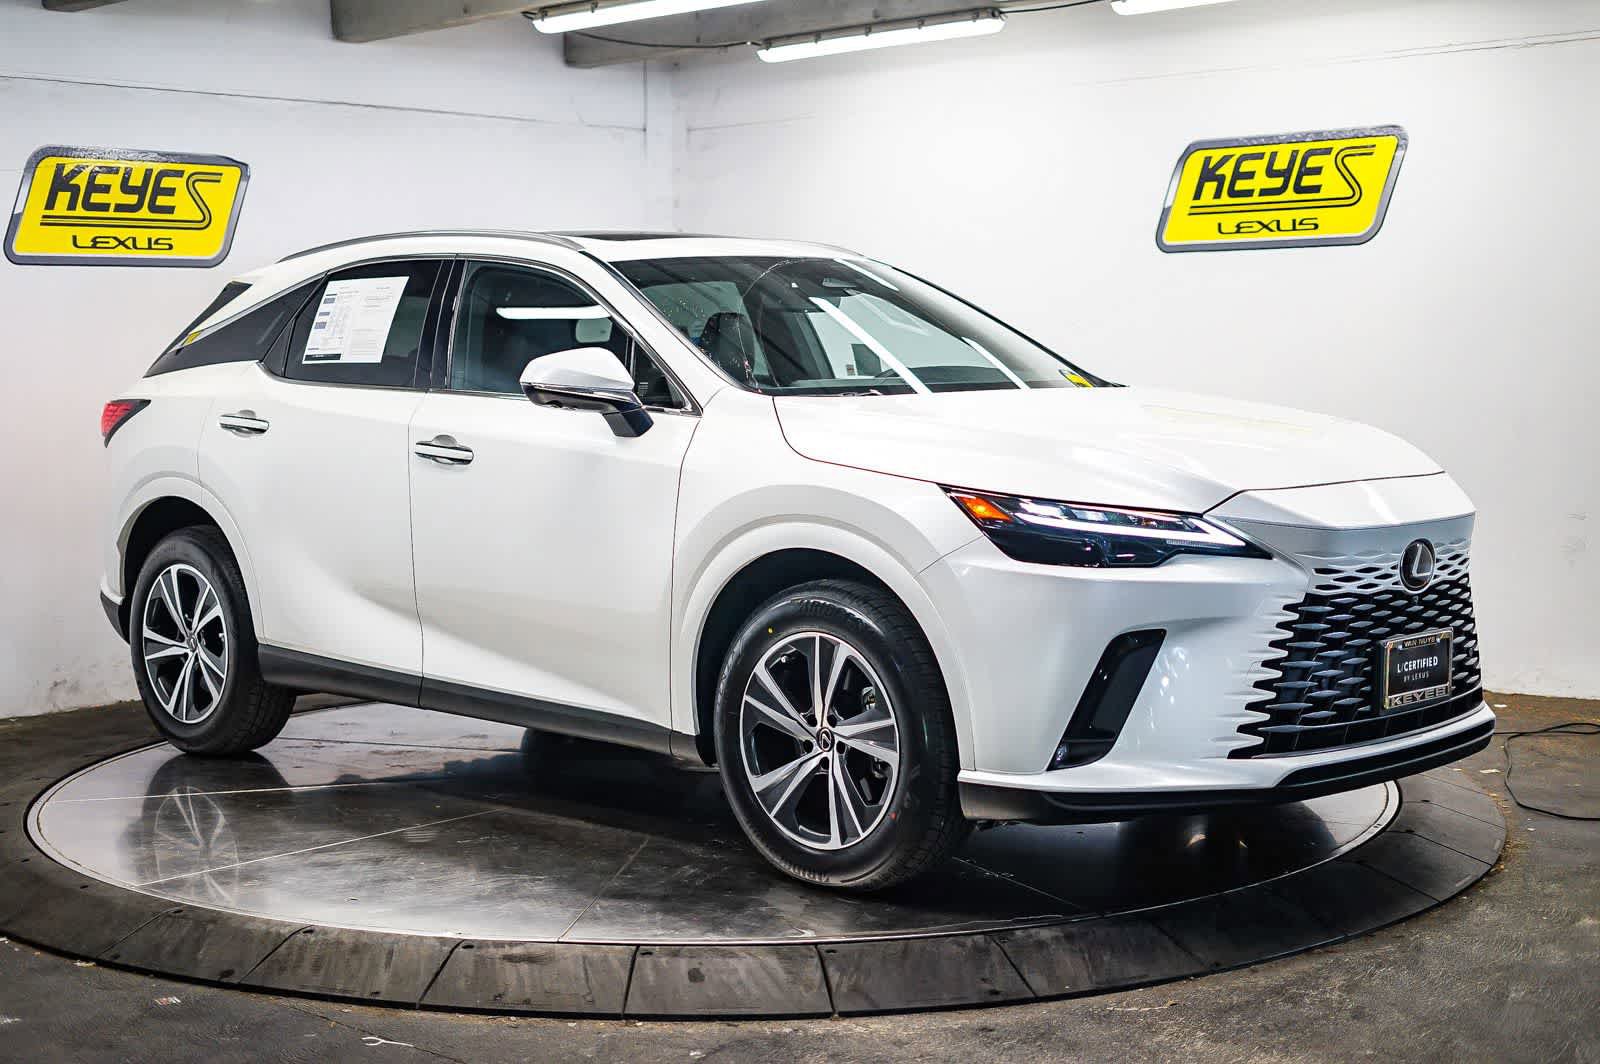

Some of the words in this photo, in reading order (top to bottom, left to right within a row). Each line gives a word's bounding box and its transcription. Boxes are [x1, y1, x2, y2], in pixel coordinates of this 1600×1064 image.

[43, 163, 223, 230] KEYES
[1190, 144, 1376, 210] KEYES
[72, 234, 174, 251] LEXUS
[1217, 217, 1319, 235] LEXUS
